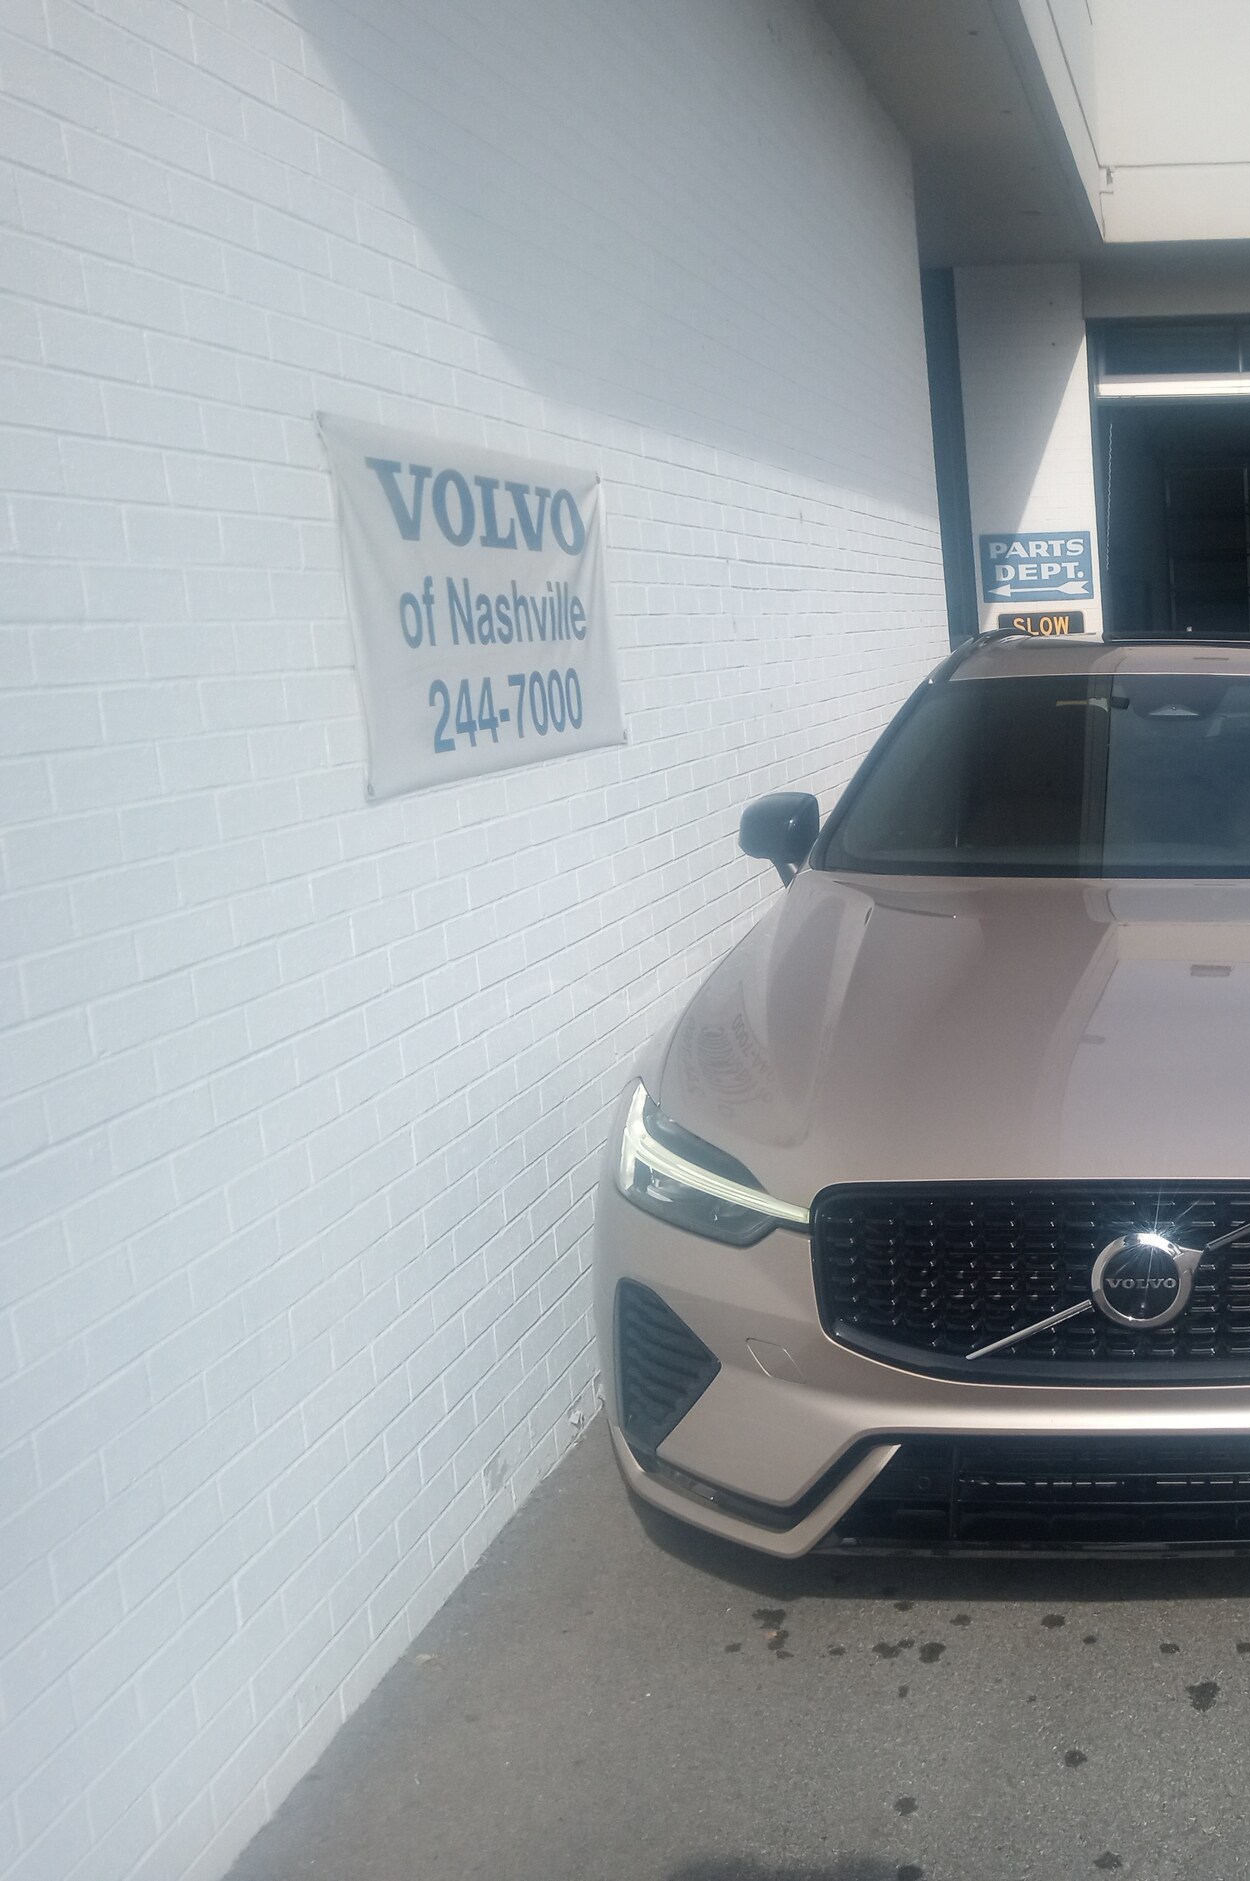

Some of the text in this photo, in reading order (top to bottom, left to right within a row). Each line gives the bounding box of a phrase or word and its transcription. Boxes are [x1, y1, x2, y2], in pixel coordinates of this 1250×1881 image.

[365, 456, 586, 556] VOLVO
[988, 538, 1084, 559] PARTS
[995, 561, 1085, 581] DEPT.
[400, 575, 587, 649] of Nashville
[1013, 616, 1069, 636] SLOW
[428, 667, 583, 754] 244-7000
[1105, 1278, 1177, 1289] VOLVO
